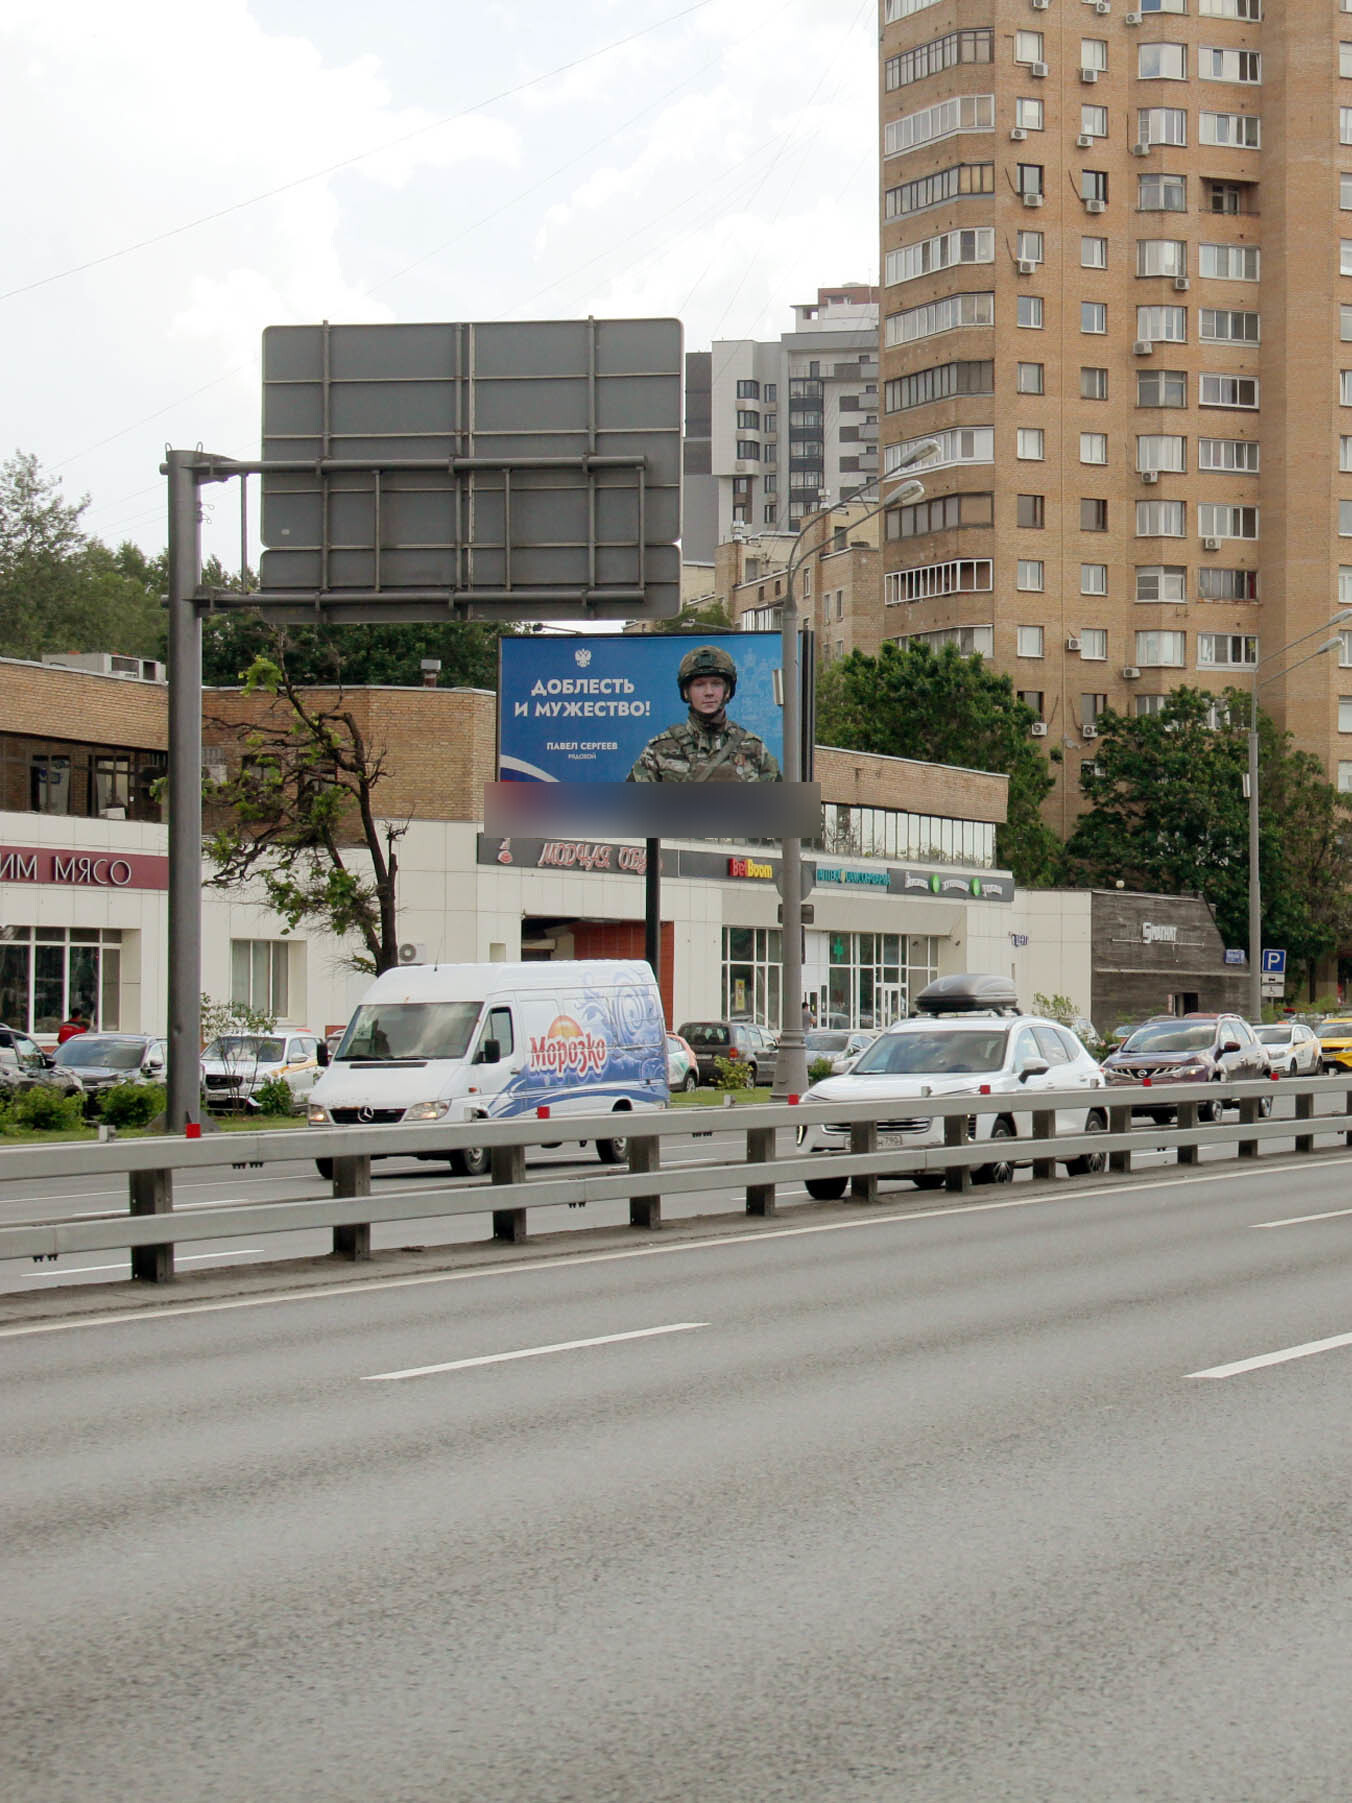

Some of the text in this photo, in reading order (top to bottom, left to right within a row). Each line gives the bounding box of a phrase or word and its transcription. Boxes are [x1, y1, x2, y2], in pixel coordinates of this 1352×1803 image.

[530, 678, 635, 696] ДОБЛЕСТЬ
[514, 701, 651, 717] И МУЖЕСТВО!
[546, 742, 618, 750] ПАВЕЛ СЕРГЕЕВ
[54, 855, 132, 886] МЯСО
[529, 1032, 606, 1073] Морозко
